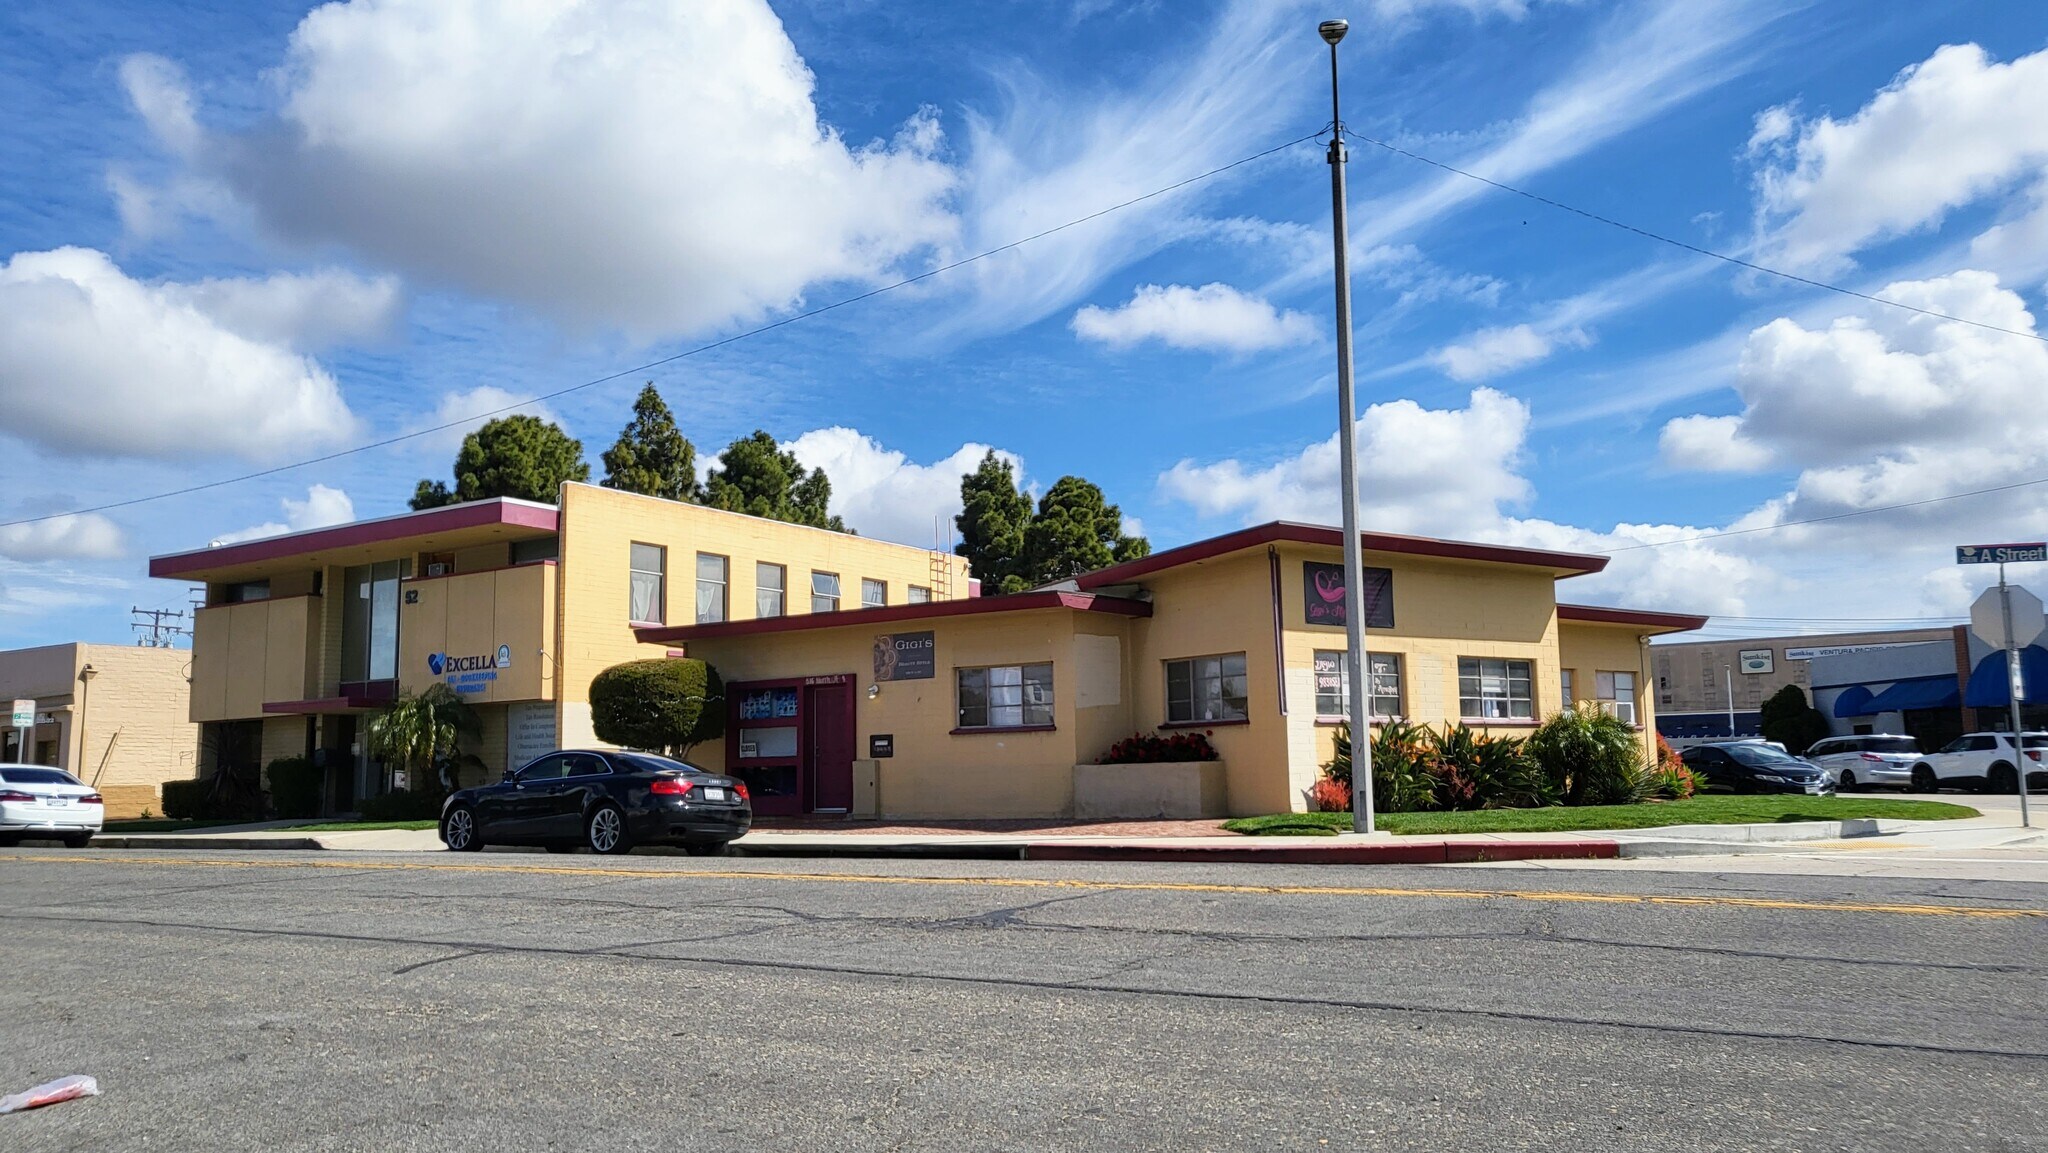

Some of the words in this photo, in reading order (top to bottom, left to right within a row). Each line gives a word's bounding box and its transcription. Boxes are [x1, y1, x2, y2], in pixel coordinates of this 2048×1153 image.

[1980, 548, 1992, 562] A
[1996, 547, 2045, 562] Street
[1742, 653, 1770, 661] Sunkist
[1819, 648, 1853, 656] VENTURA
[446, 654, 497, 672] EXCELLA
